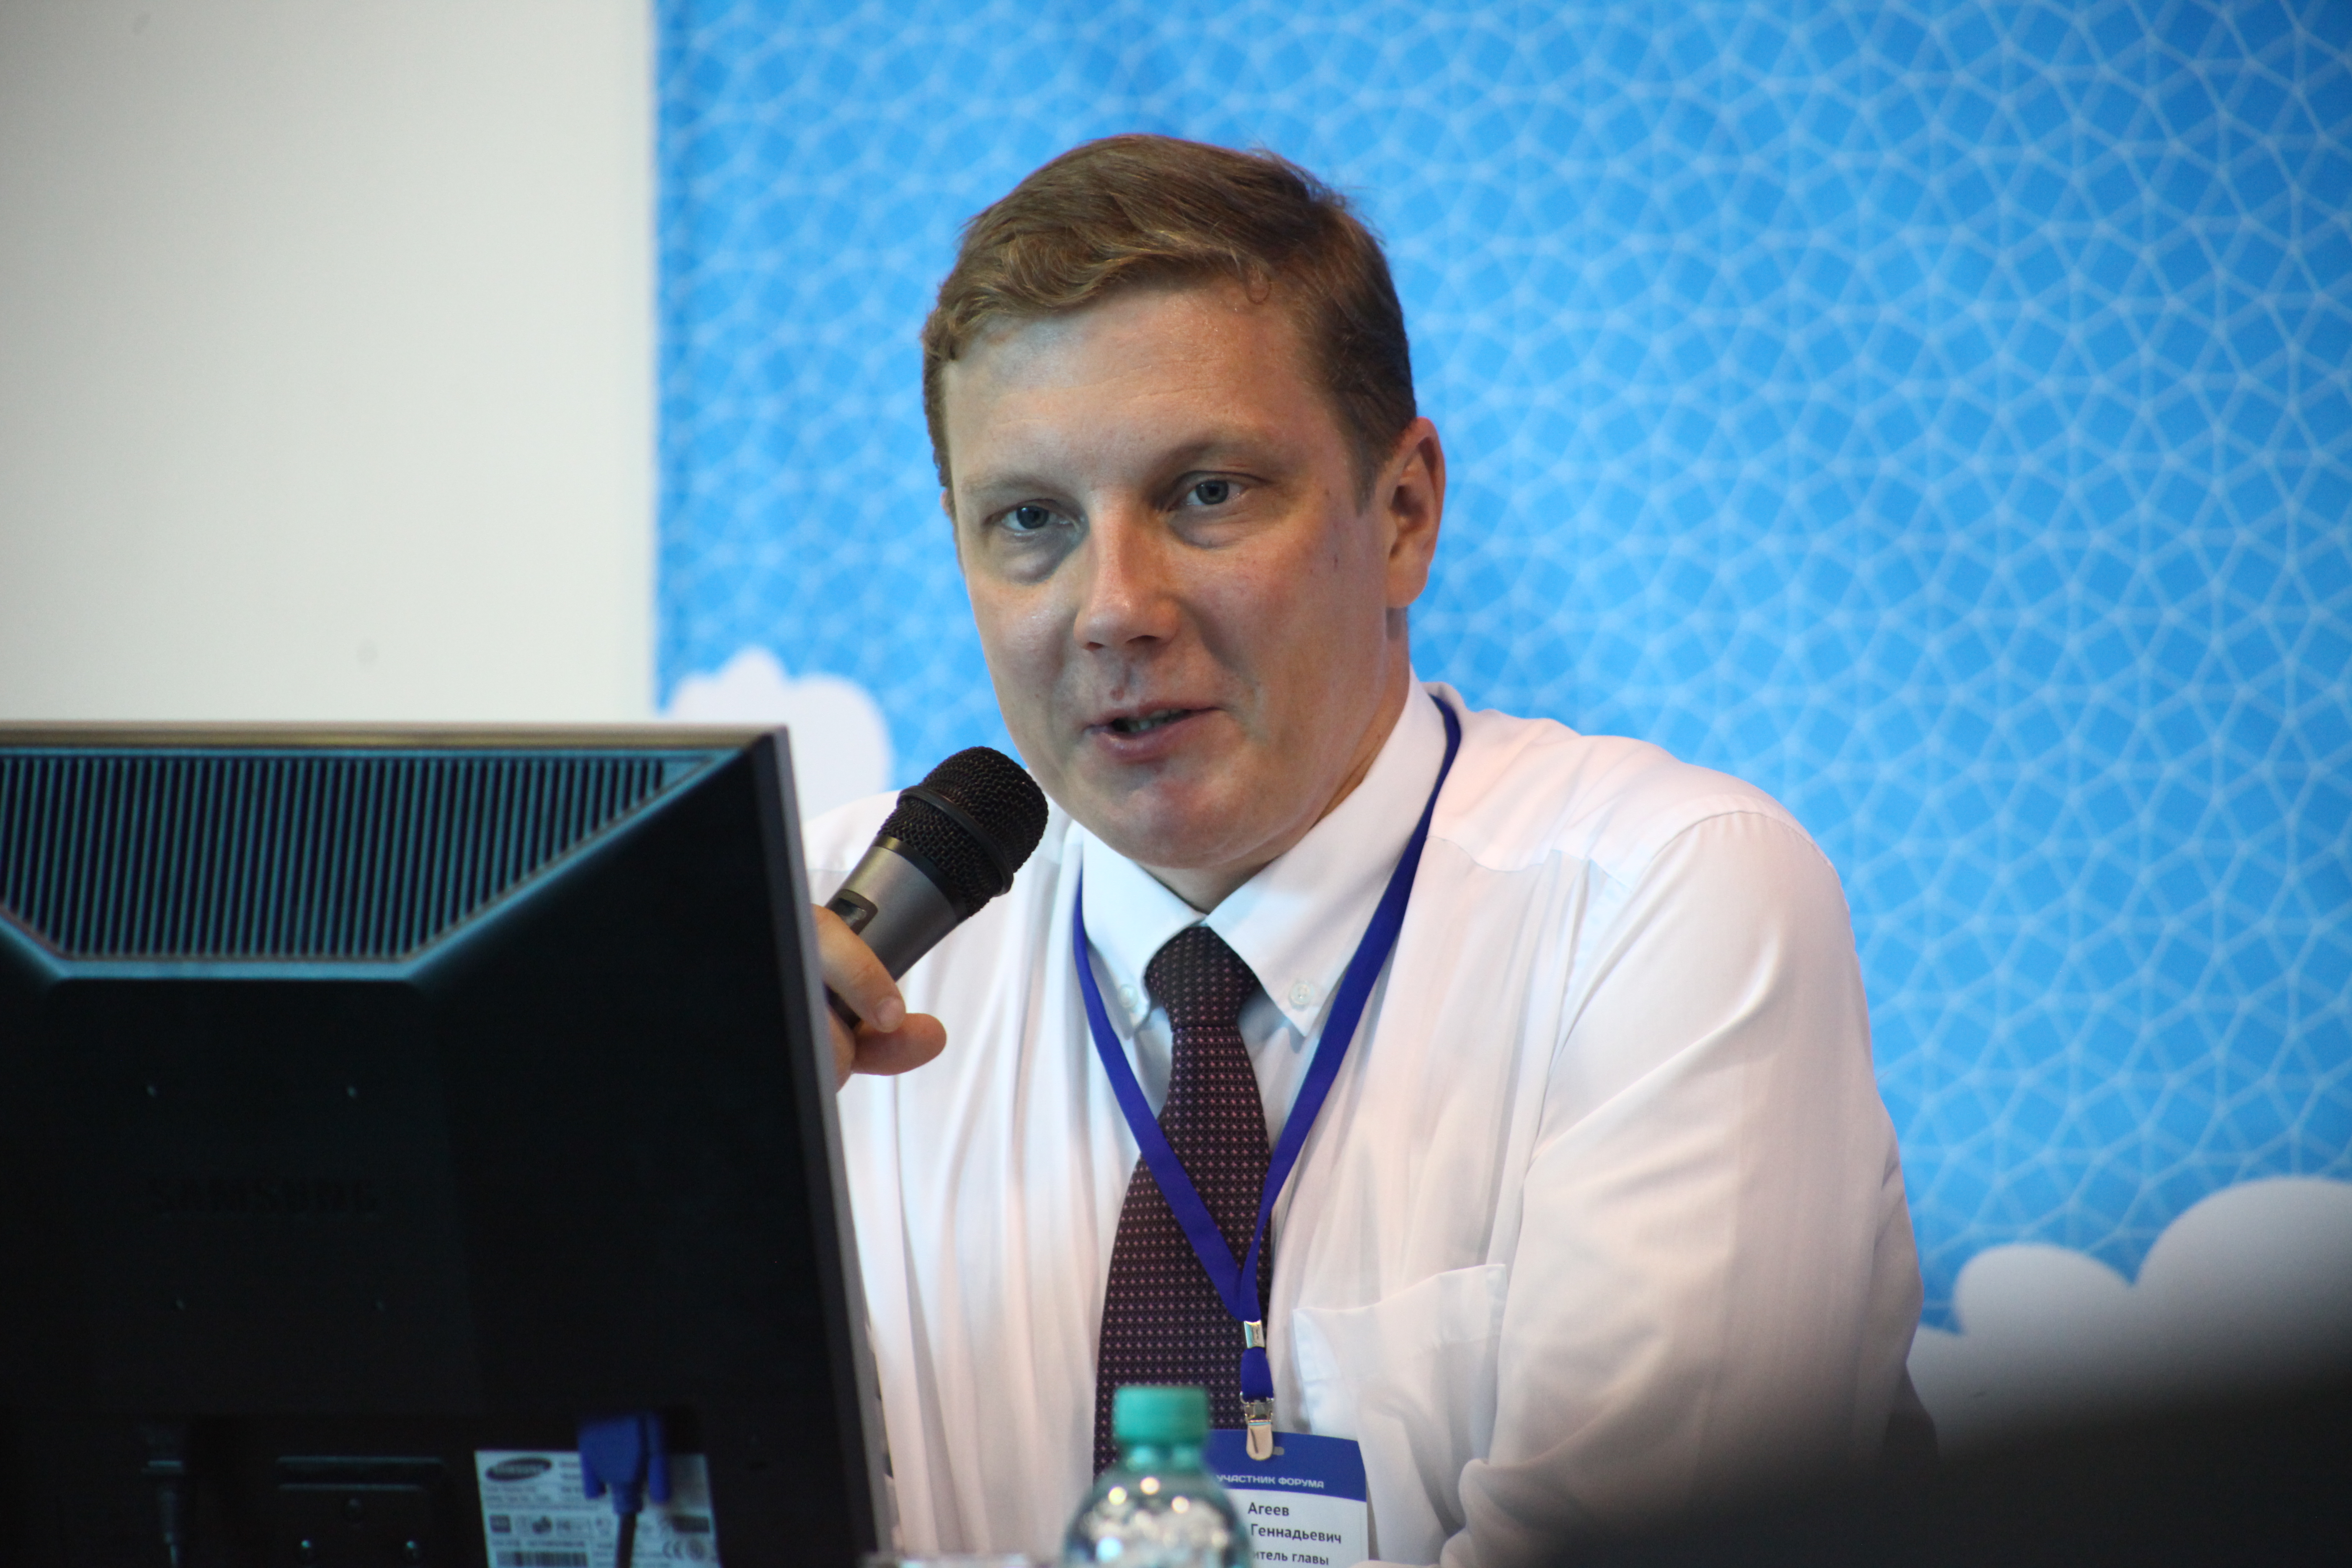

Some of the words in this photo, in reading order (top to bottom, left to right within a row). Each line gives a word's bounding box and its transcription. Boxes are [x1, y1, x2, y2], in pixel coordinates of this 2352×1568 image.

[148, 1177, 379, 1212] SAMSUNG
[1216, 1474, 1276, 1485] УЧАСТНИК
[1278, 1477, 1324, 1488] ФОРУМА
[1248, 1502, 1289, 1516] Агеев
[1251, 1523, 1341, 1544] Геннадьевич
[1292, 1553, 1329, 1565] главы
